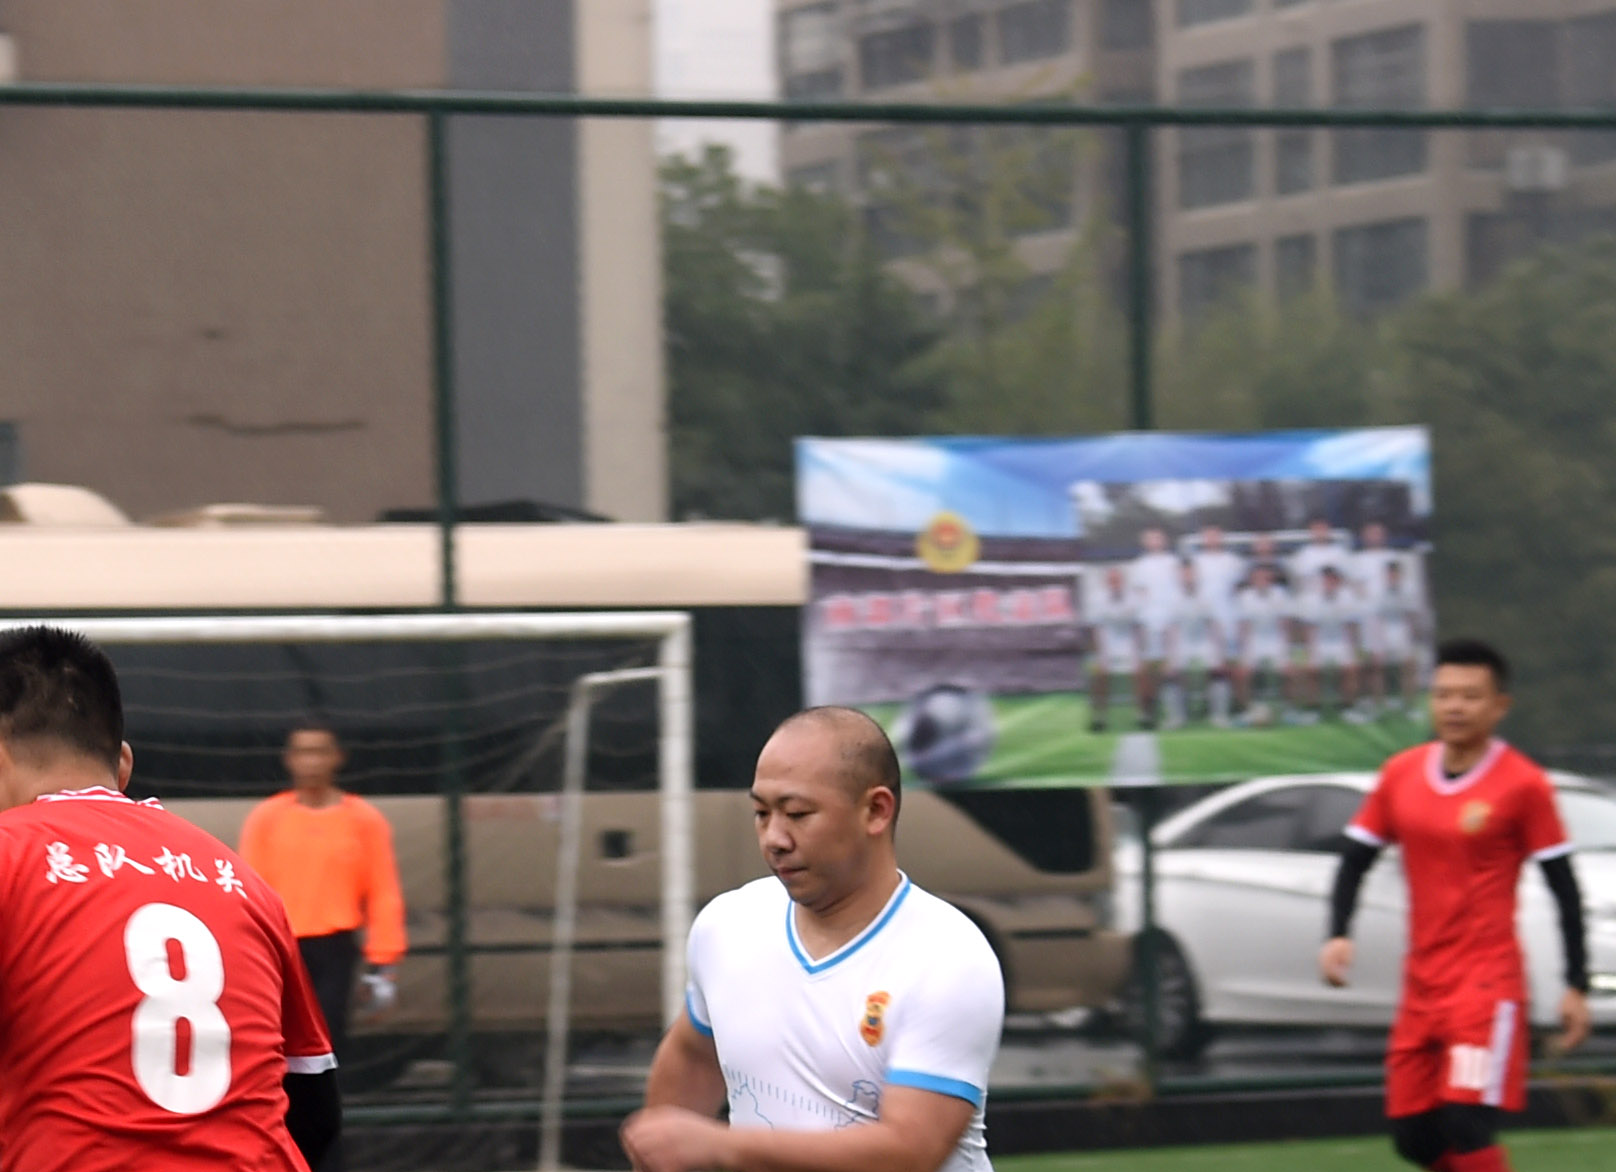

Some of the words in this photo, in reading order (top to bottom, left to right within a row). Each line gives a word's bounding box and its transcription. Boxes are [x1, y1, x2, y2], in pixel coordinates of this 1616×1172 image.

[45, 840, 248, 900] 总队机关
[123, 902, 232, 1115] 8
